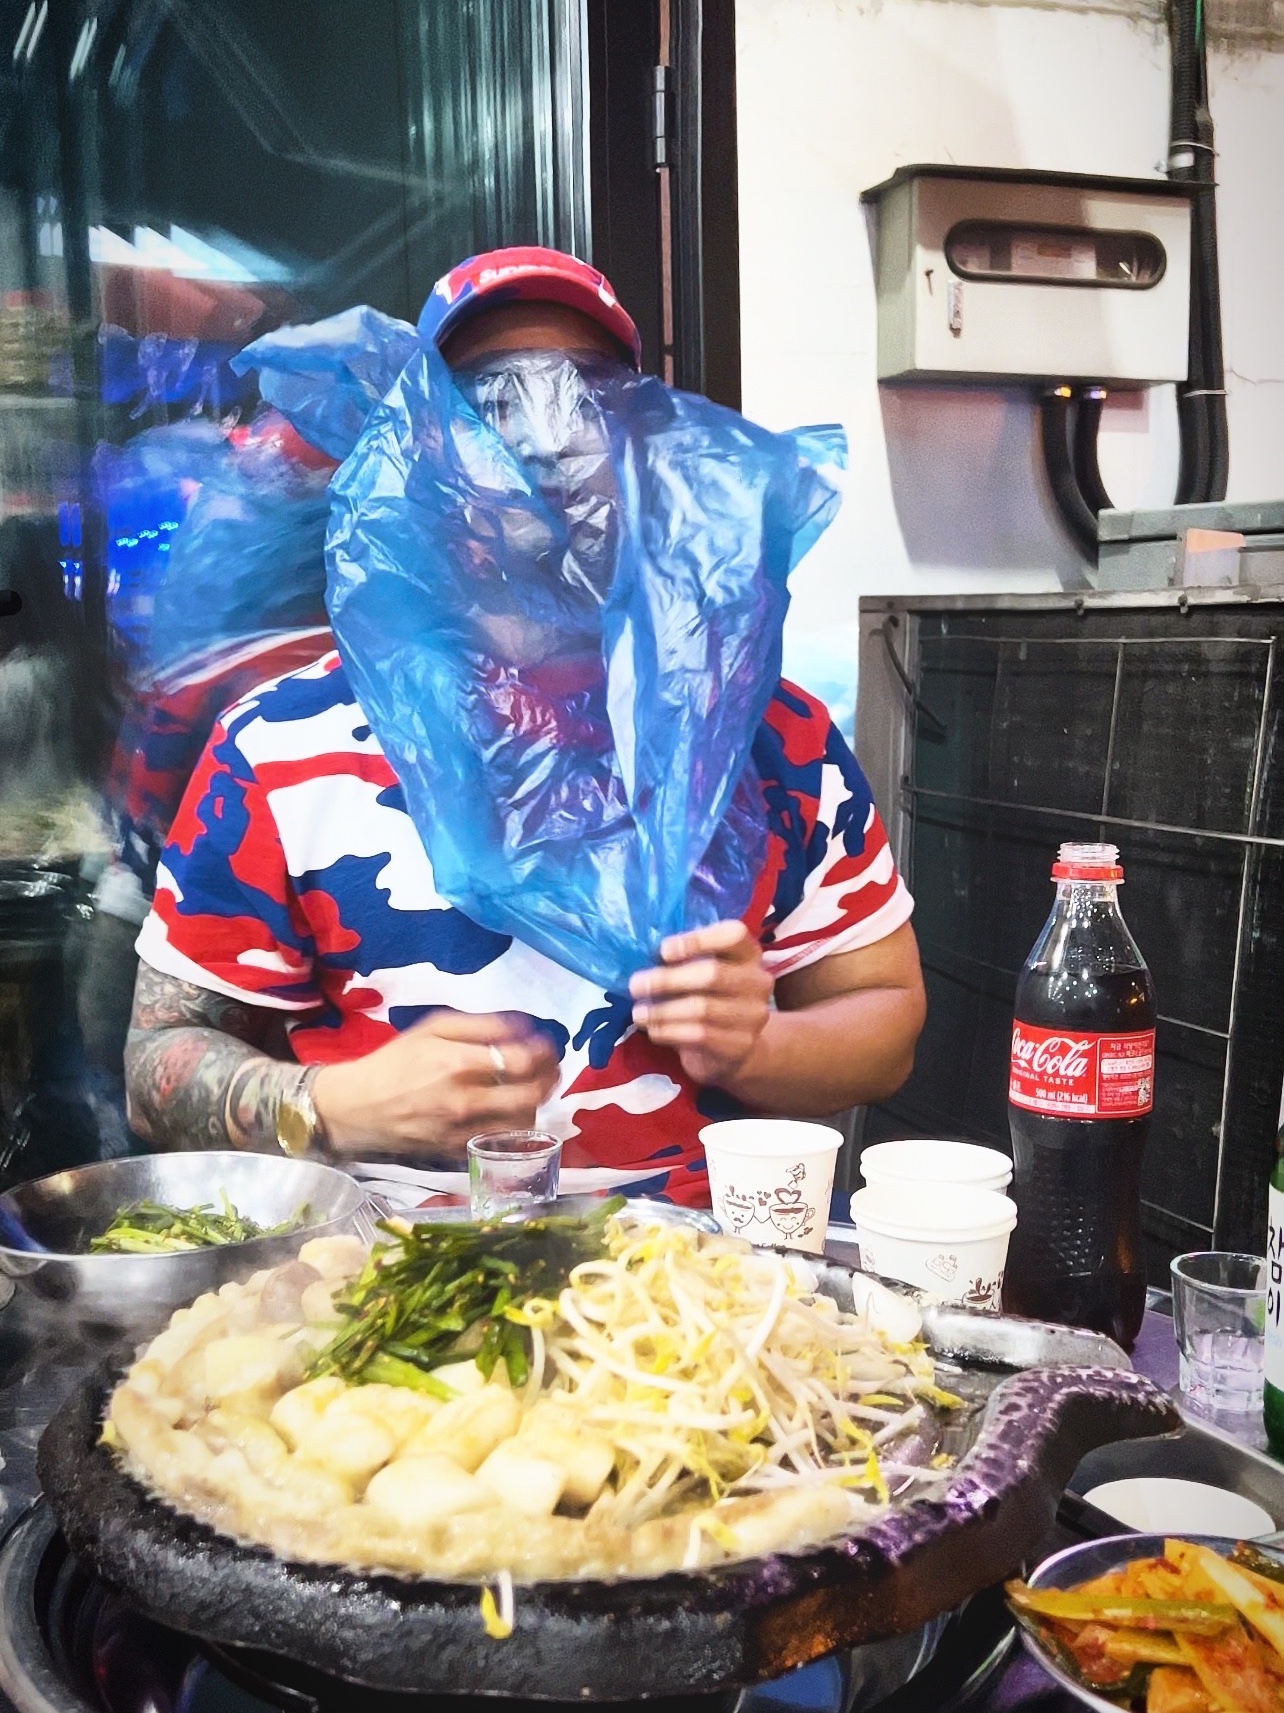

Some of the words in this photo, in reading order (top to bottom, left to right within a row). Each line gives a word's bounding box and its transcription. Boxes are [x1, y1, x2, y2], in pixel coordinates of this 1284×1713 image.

[1011, 1027, 1096, 1077] Coca-Cola
[1043, 1075, 1075, 1086] TASTE
[1035, 1087, 1047, 1099] 500
